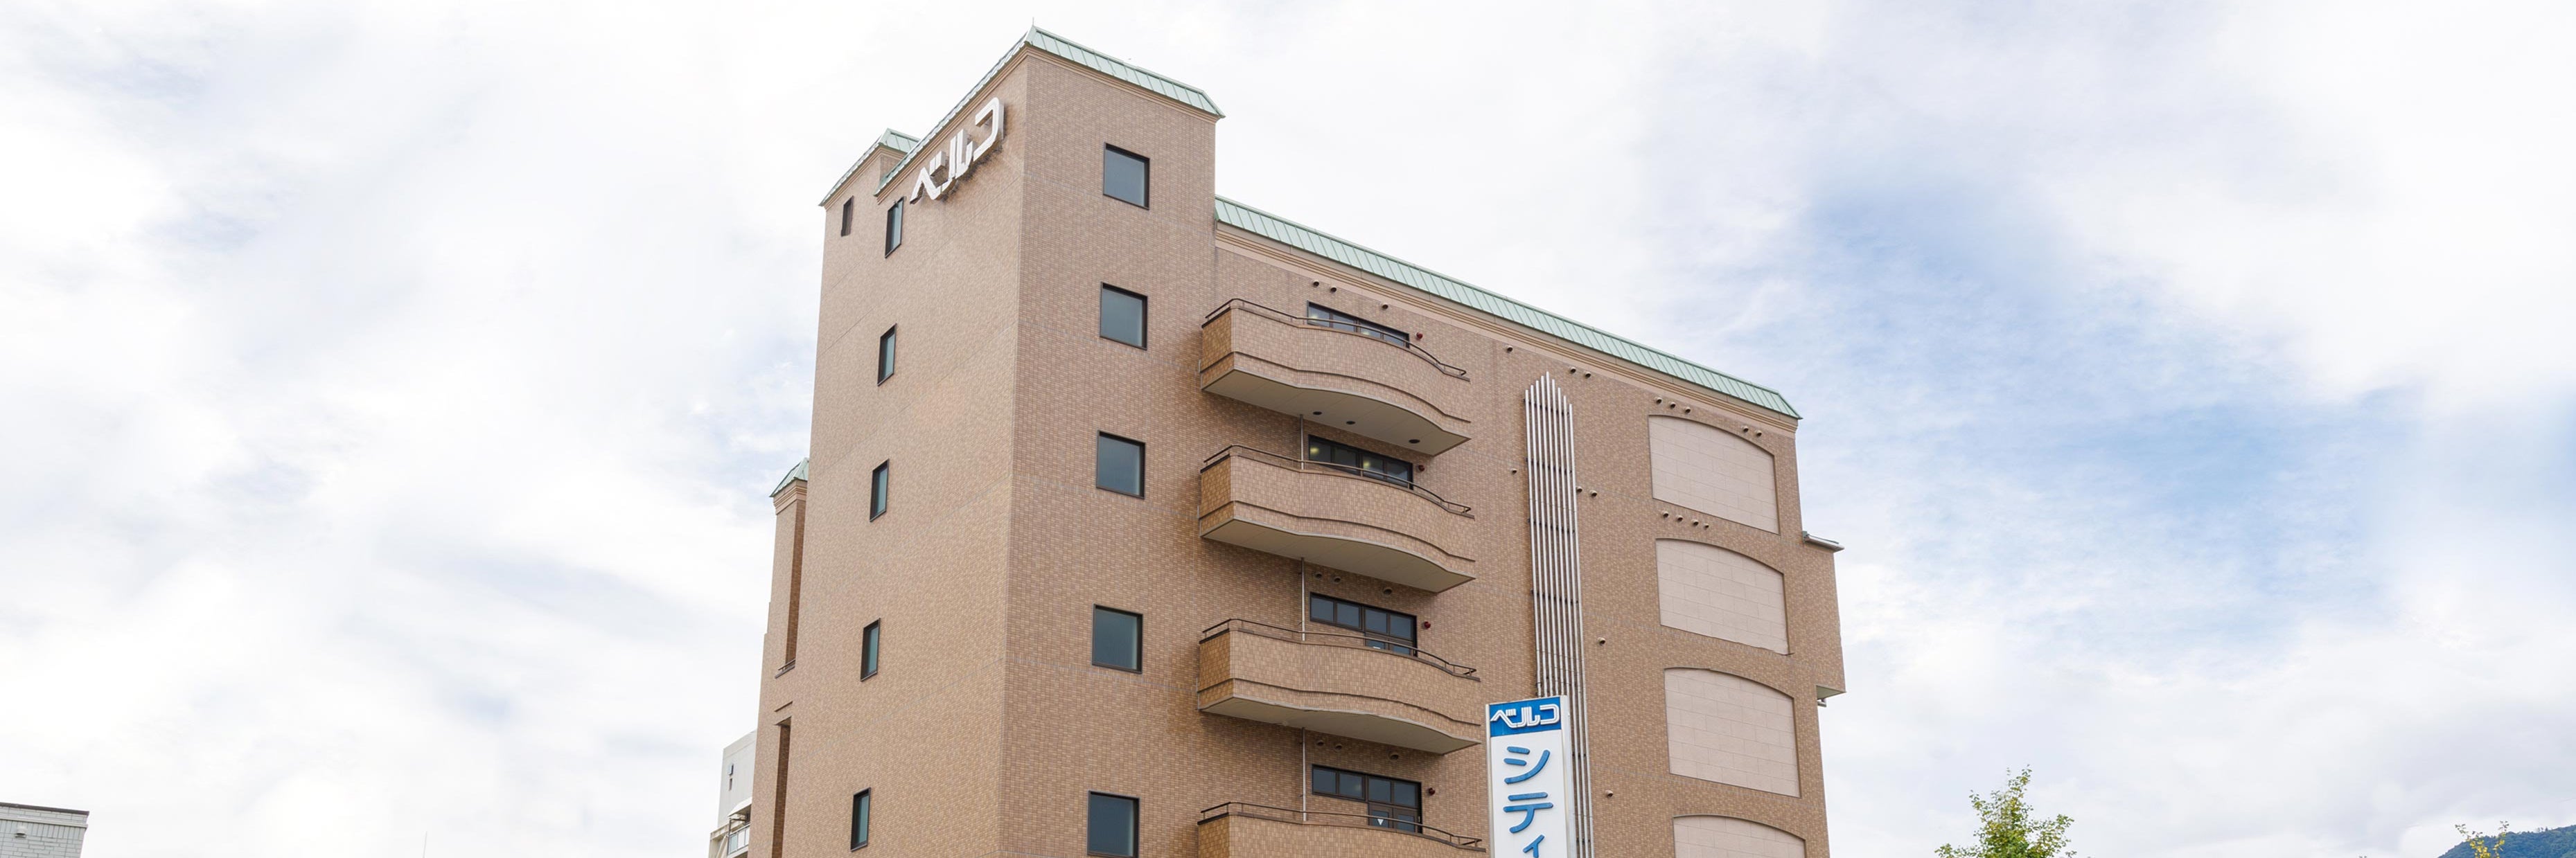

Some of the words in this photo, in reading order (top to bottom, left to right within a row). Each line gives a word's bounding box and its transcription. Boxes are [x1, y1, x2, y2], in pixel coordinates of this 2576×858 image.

[910, 97, 1003, 203] ベルコ
[1490, 704, 1560, 729] ベルコ
